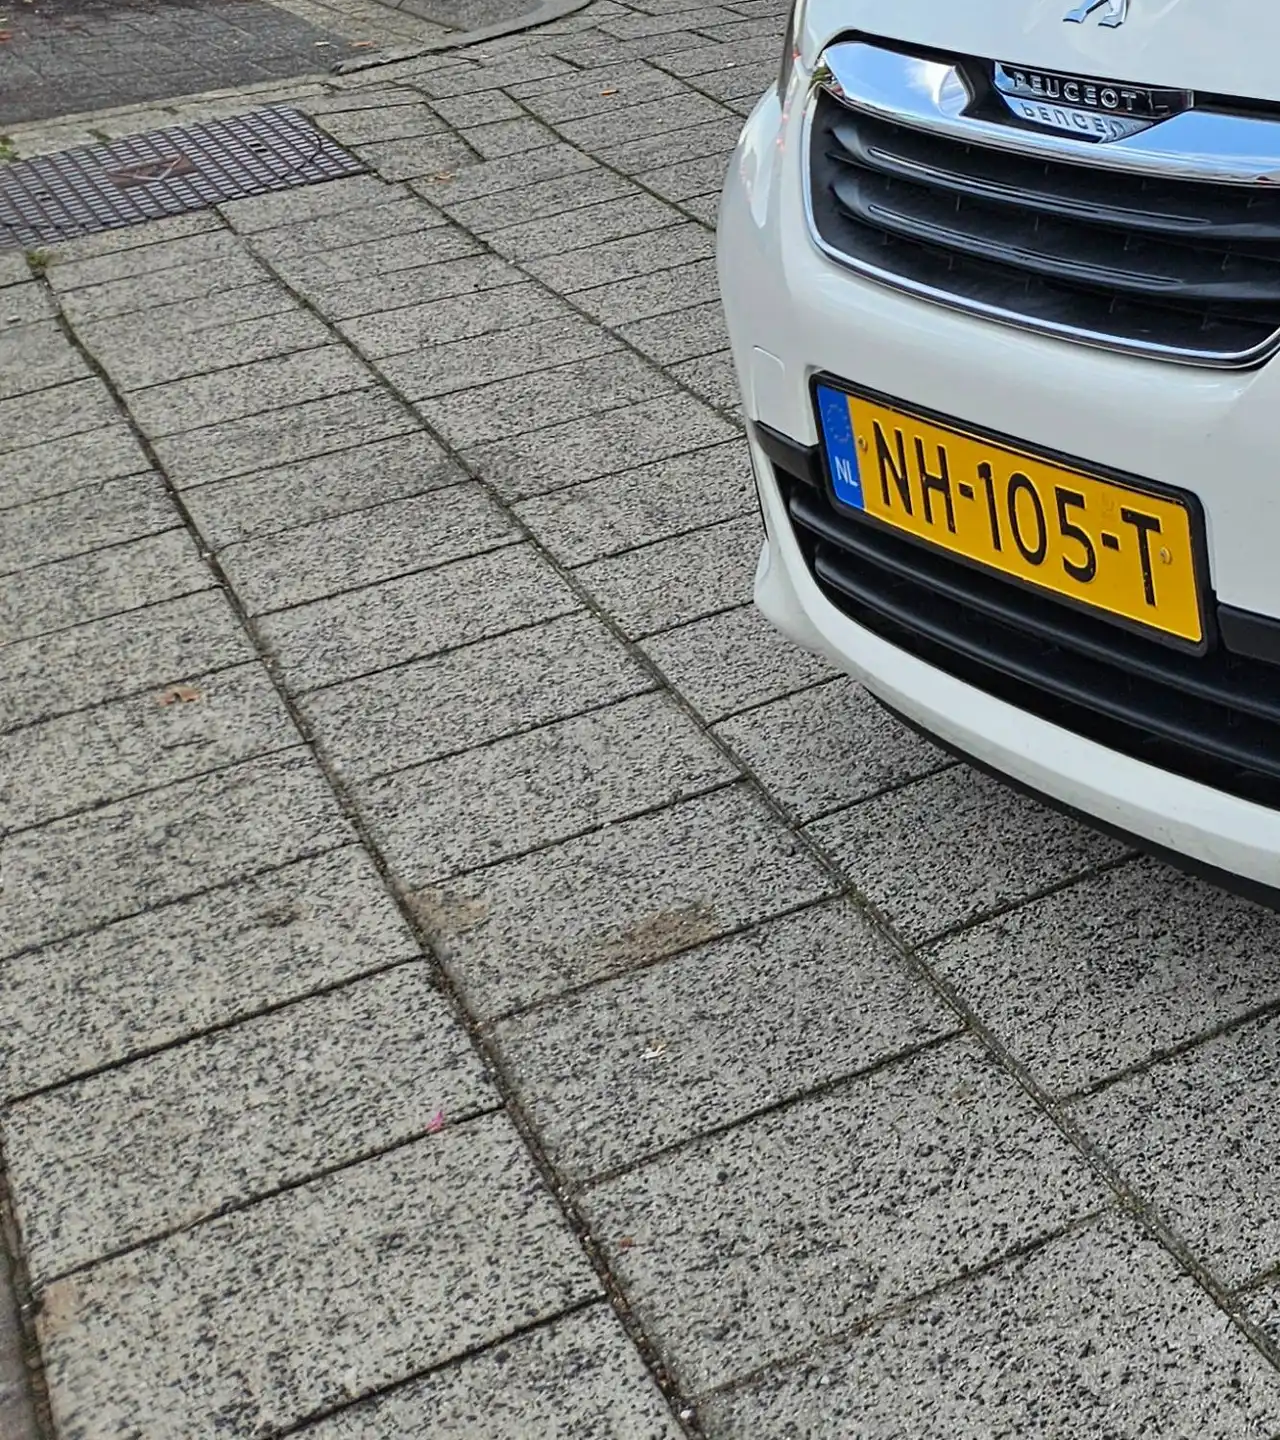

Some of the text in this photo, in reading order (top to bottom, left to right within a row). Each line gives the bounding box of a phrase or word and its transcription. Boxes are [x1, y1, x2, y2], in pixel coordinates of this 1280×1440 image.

[1013, 71, 1137, 111] PEUGEOT
[834, 457, 859, 488] NL
[872, 419, 1162, 607] NH-105-T
